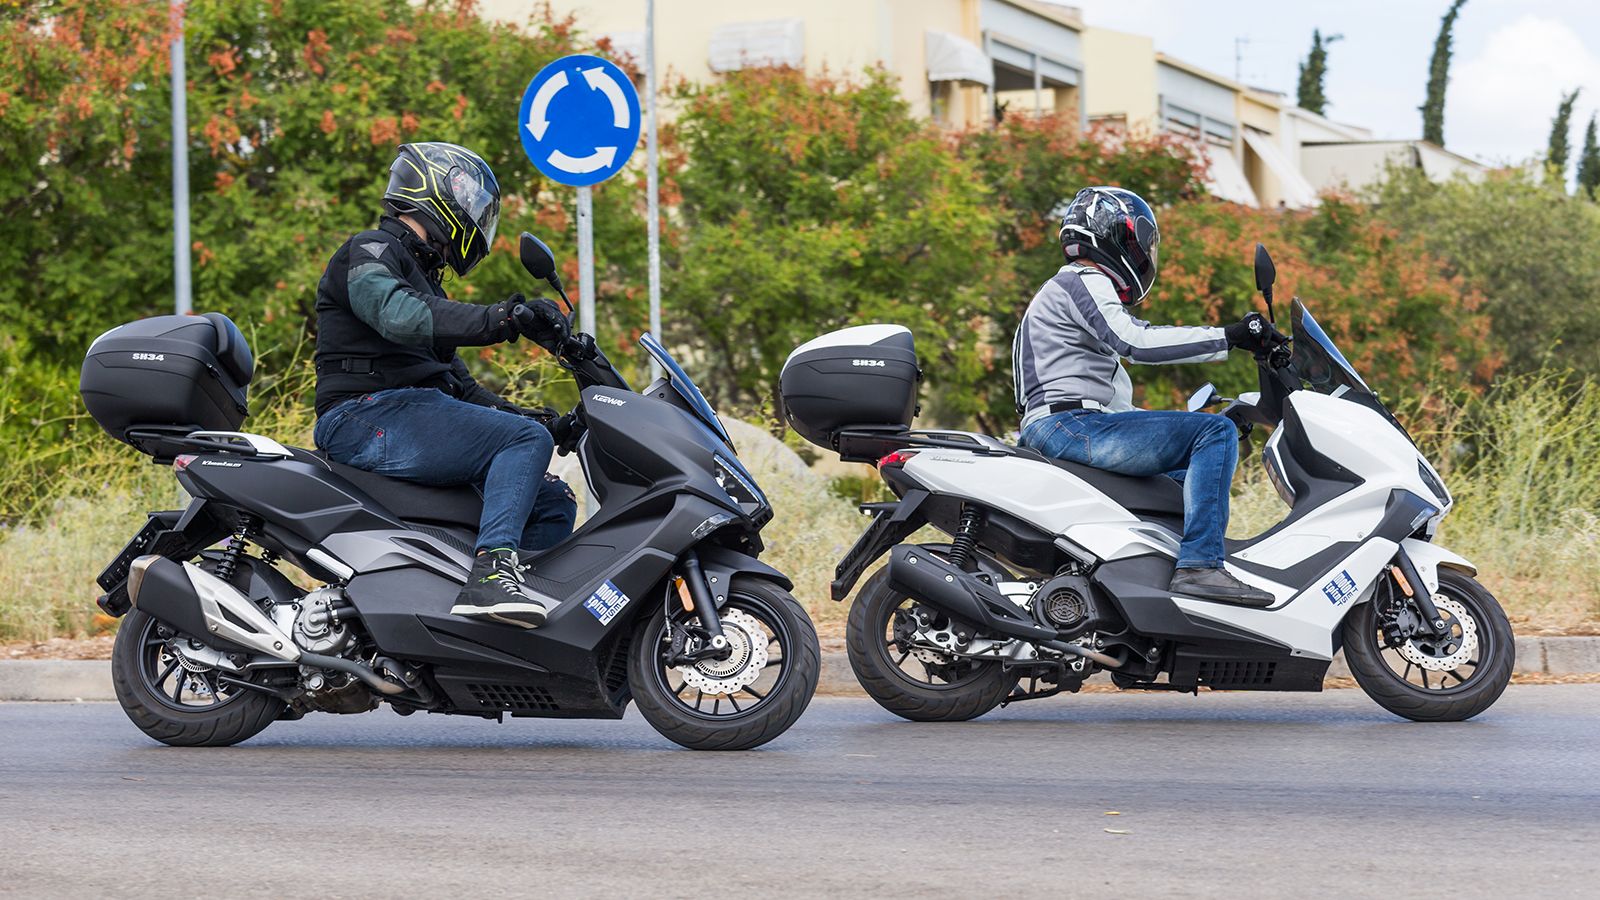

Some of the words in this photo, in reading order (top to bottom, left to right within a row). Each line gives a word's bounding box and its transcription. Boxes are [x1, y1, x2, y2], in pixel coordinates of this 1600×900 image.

[132, 352, 164, 361] SH34
[852, 359, 885, 367] SH34
[592, 393, 627, 407] KEEWAY
[1333, 572, 1353, 595] moto
[595, 583, 620, 607] moto
[1337, 586, 1359, 607] TEST
[603, 596, 627, 621] TEST
